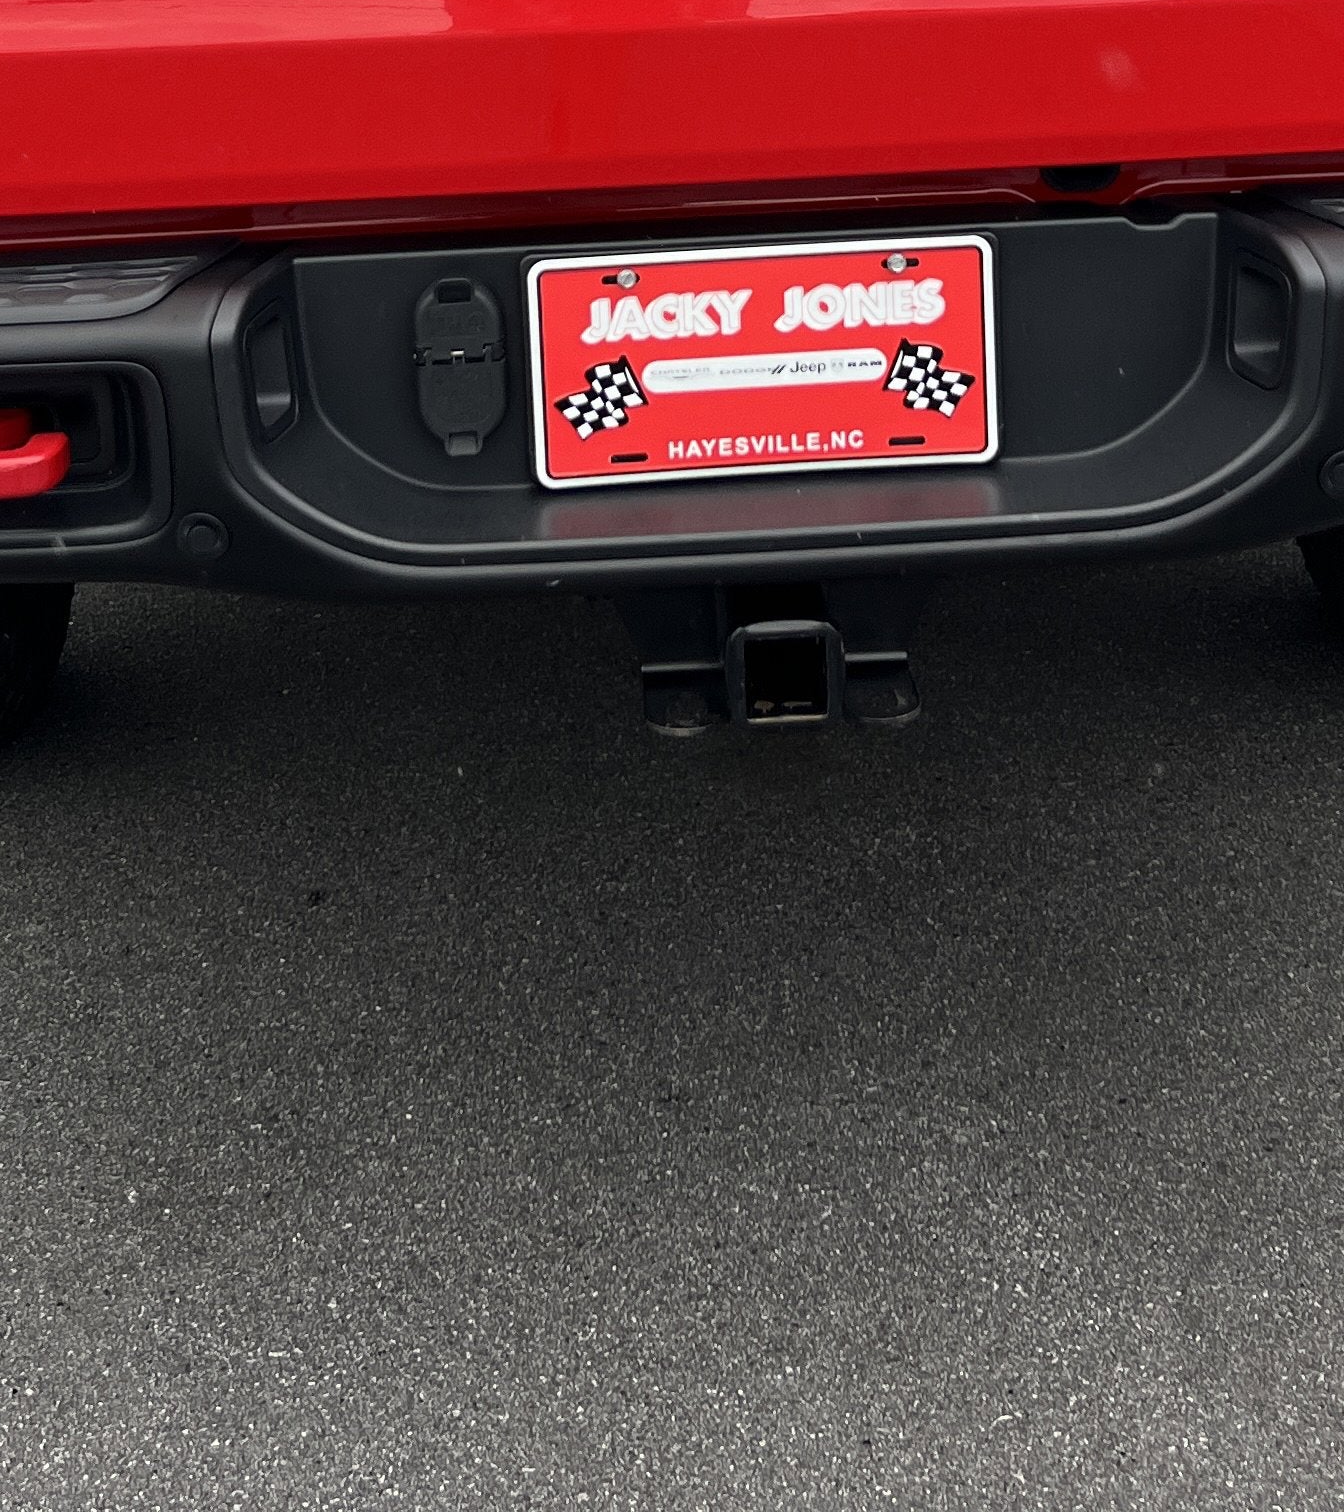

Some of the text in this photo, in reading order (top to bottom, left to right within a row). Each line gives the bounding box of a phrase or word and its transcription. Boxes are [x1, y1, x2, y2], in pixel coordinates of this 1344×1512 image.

[581, 278, 947, 344] JACKY JONES
[789, 361, 827, 374] Jeep
